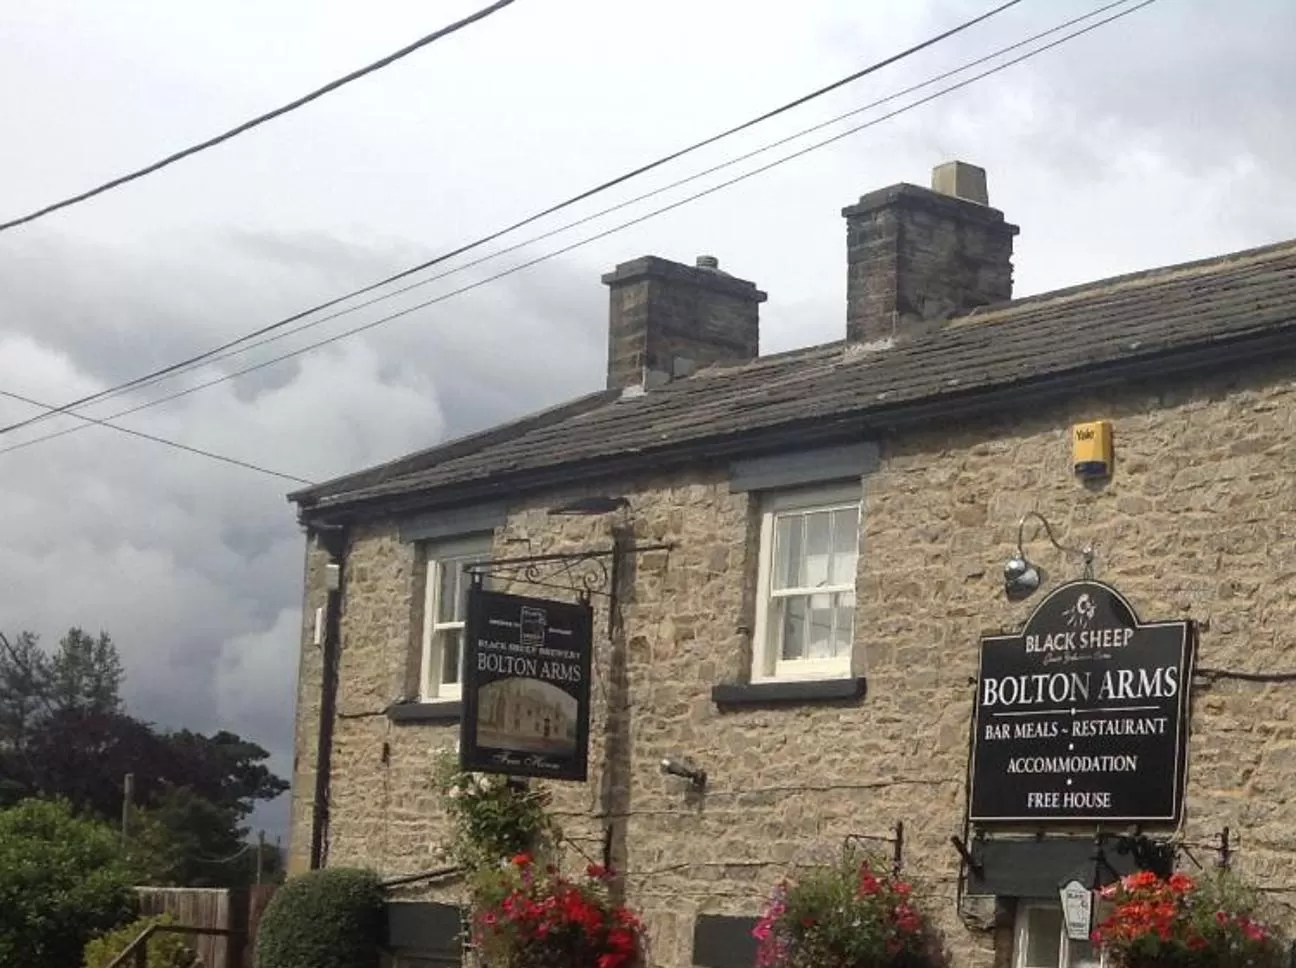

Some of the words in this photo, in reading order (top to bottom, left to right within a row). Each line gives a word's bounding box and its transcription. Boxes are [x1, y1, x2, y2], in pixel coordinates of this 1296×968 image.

[1025, 632, 1076, 653] BLACK
[1079, 627, 1134, 650] SHEEP
[477, 652, 537, 677] BOLTON
[540, 663, 581, 682] ARMS
[982, 671, 1091, 706] BOLTON
[1098, 666, 1178, 700] ARMS
[984, 724, 1010, 740] BAR
[1013, 721, 1059, 738] MEALS
[1072, 717, 1168, 737] RESTAURANT
[1006, 755, 1138, 773] ACCOMMODATION
[1027, 792, 1060, 808] FREE
[1063, 792, 1112, 808] HOUSE
